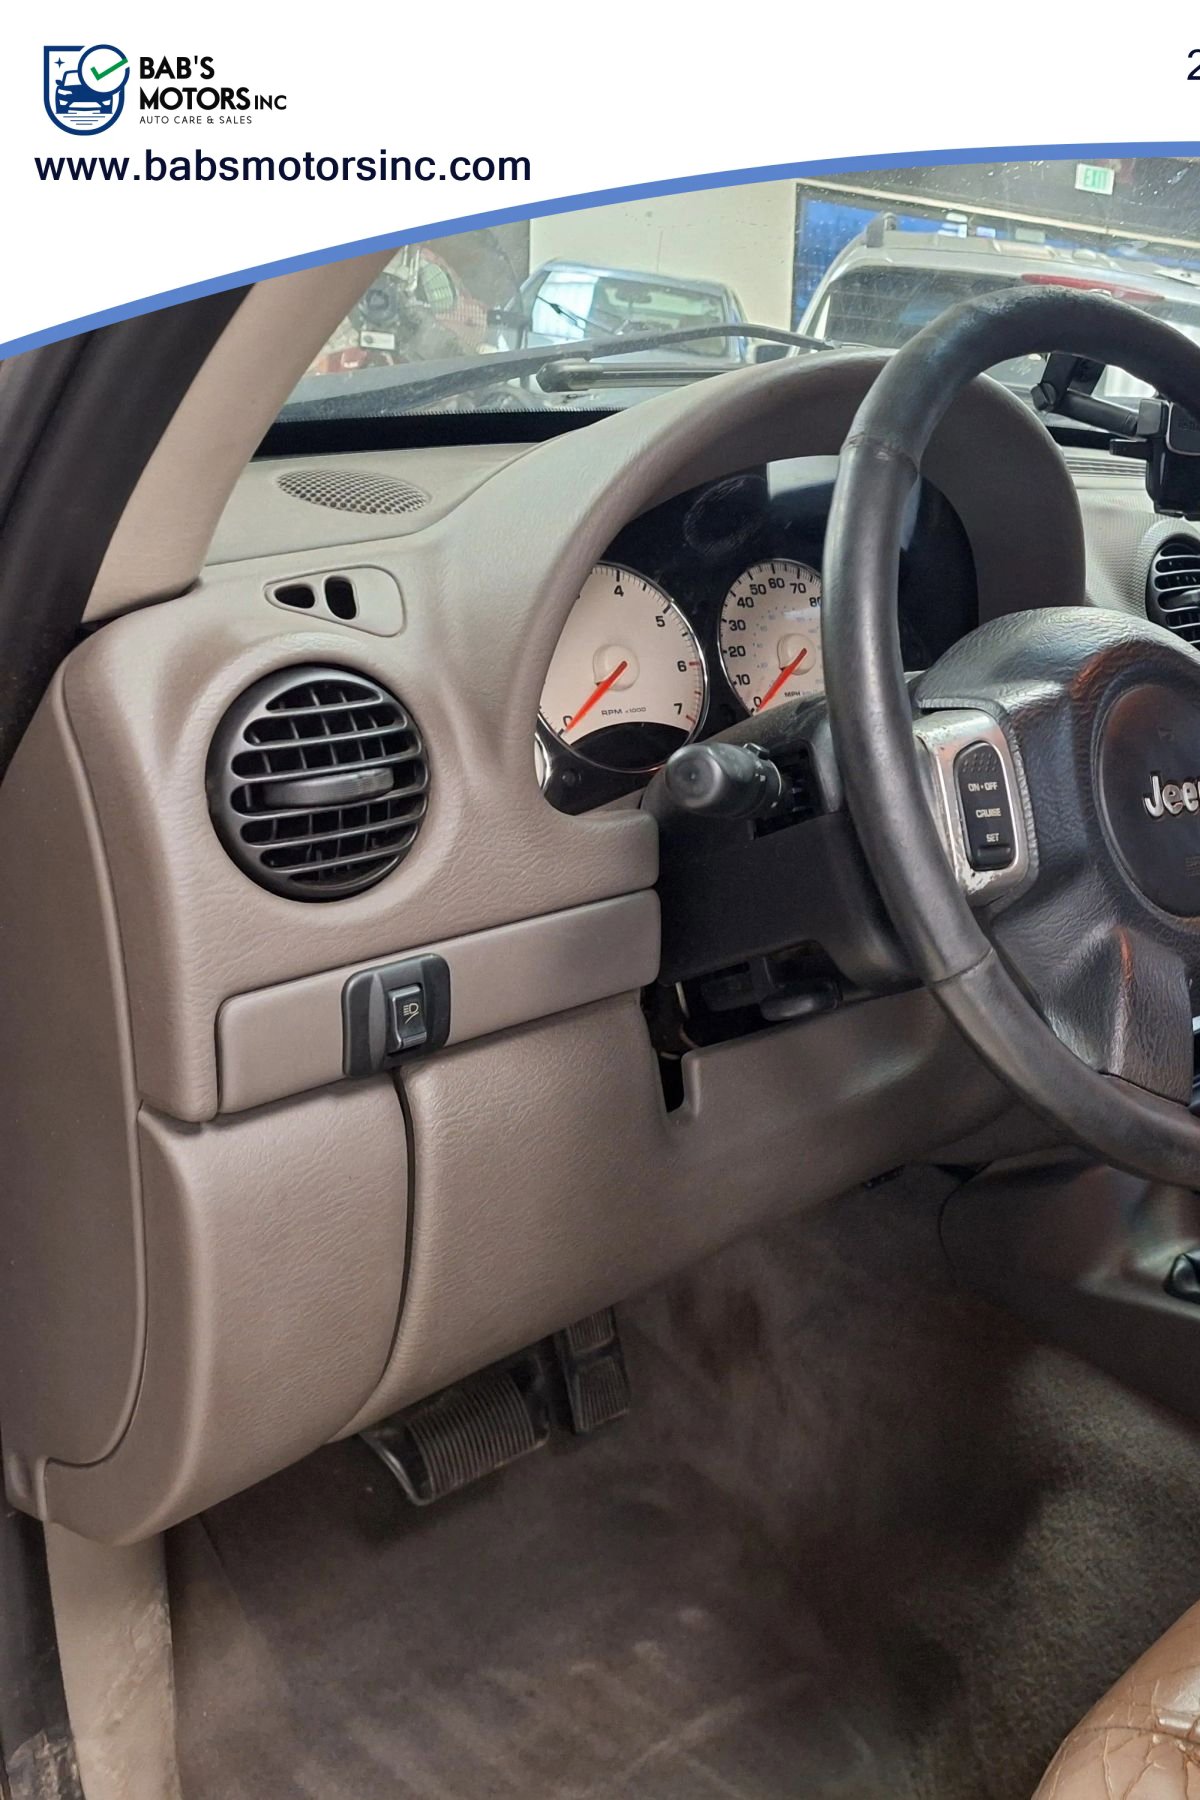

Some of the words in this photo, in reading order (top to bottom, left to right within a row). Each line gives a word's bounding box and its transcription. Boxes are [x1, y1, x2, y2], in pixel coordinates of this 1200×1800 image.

[768, 578, 785, 589] 60
[790, 583, 806, 594] 70
[614, 585, 624, 597] 4
[750, 584, 766, 595] 50
[737, 597, 754, 608] 40
[655, 616, 666, 627] 5
[728, 620, 746, 631] 30
[728, 646, 746, 657] 20
[677, 661, 687, 672] 6
[736, 674, 750, 685] 10
[601, 708, 623, 716] RPM
[674, 703, 683, 714] 7
[975, 808, 1002, 818] CRUISE
[986, 833, 1000, 843] SET
